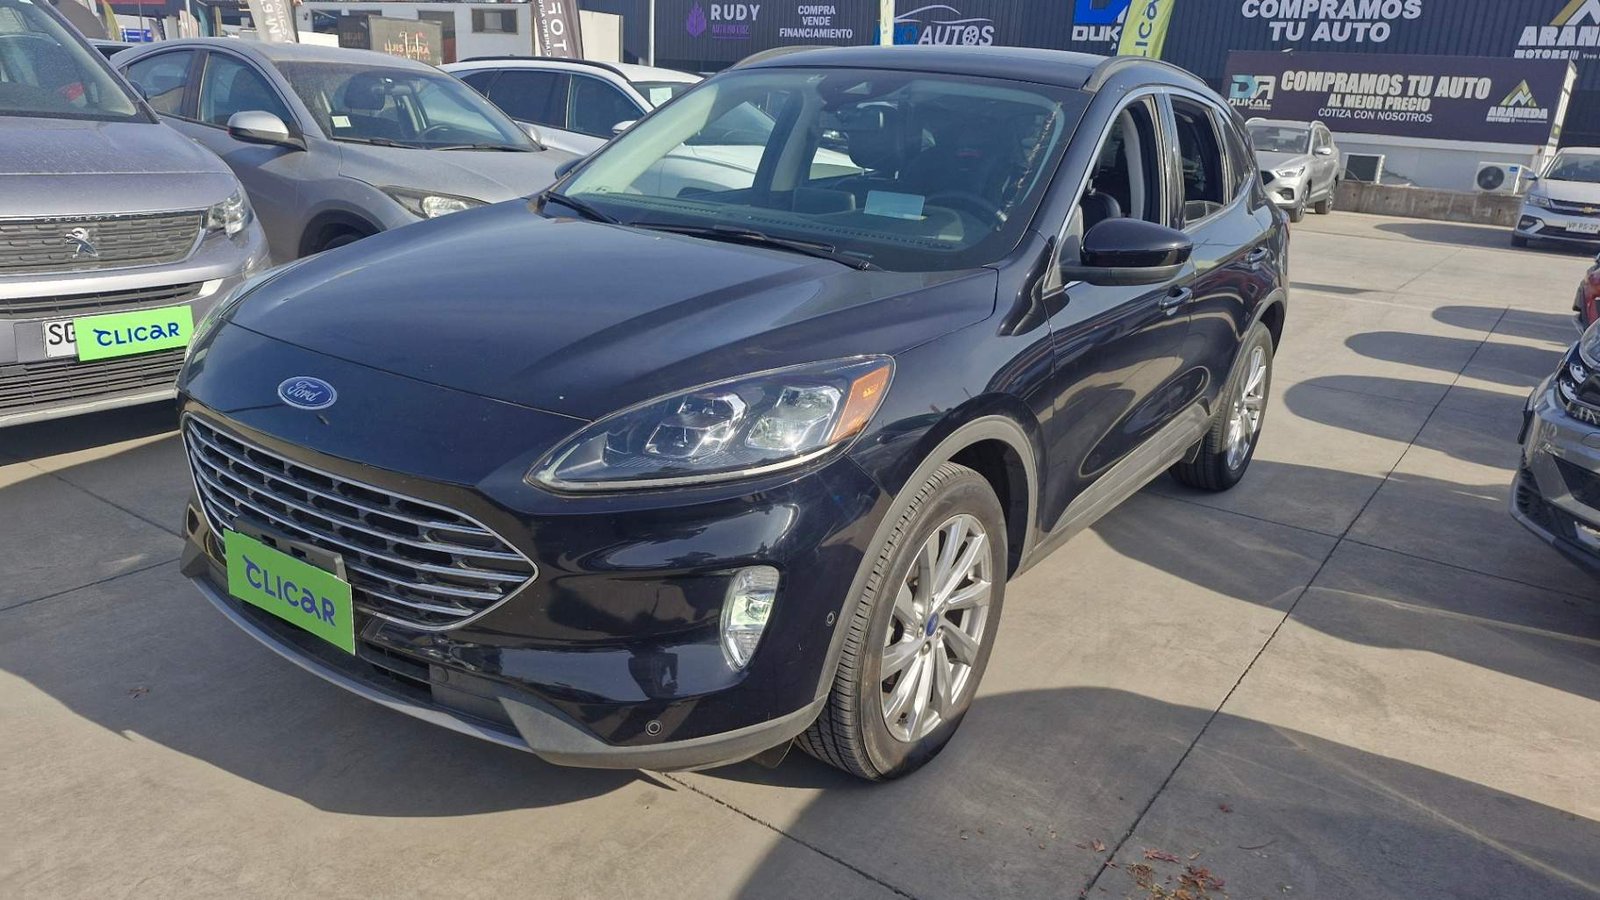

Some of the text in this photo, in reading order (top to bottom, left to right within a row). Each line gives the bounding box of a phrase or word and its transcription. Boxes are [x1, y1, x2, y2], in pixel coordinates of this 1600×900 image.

[710, 4, 761, 21] RUDY
[797, 5, 836, 15] COMPRA
[1241, 0, 1422, 19] COMPRAMOS
[802, 16, 831, 26] VENDE
[779, 27, 853, 39] FINANCIAMIENTO
[918, 25, 995, 46] AUTOS
[1269, 21, 1391, 43] TU AUTO
[1518, 26, 1600, 46] ARAN
[1281, 70, 1491, 99] COMPRAMOS TU AUTO
[1327, 93, 1431, 112] AL MEJOR PRECIO
[1318, 107, 1433, 123] COTIZA CON NOSOTROS
[287, 380, 322, 401] Ford
